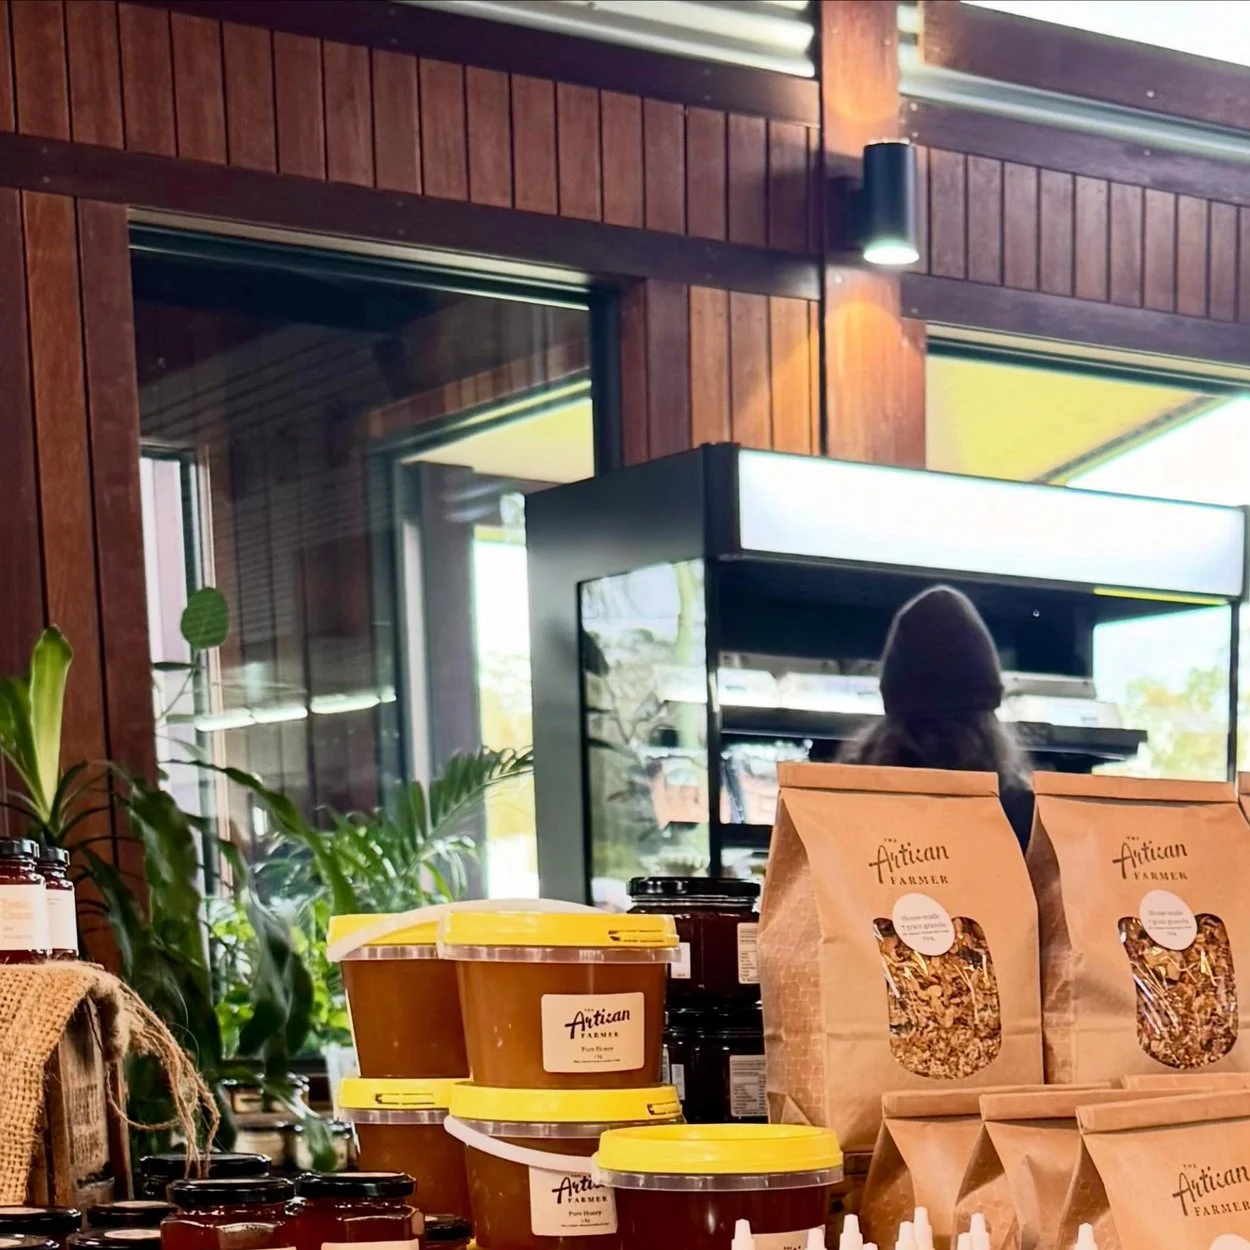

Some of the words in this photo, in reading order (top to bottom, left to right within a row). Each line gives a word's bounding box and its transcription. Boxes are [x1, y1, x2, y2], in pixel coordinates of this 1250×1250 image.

[868, 842, 950, 884] Artisan
[1112, 840, 1188, 880] Artisan
[890, 875, 949, 885] FARMER
[1133, 871, 1188, 881] FARMER
[564, 1009, 630, 1040] Artisan
[581, 1031, 620, 1039] FARMER
[552, 1174, 604, 1204] Arti
[568, 1195, 608, 1204] FARMER
[1172, 1165, 1250, 1217] Artisan
